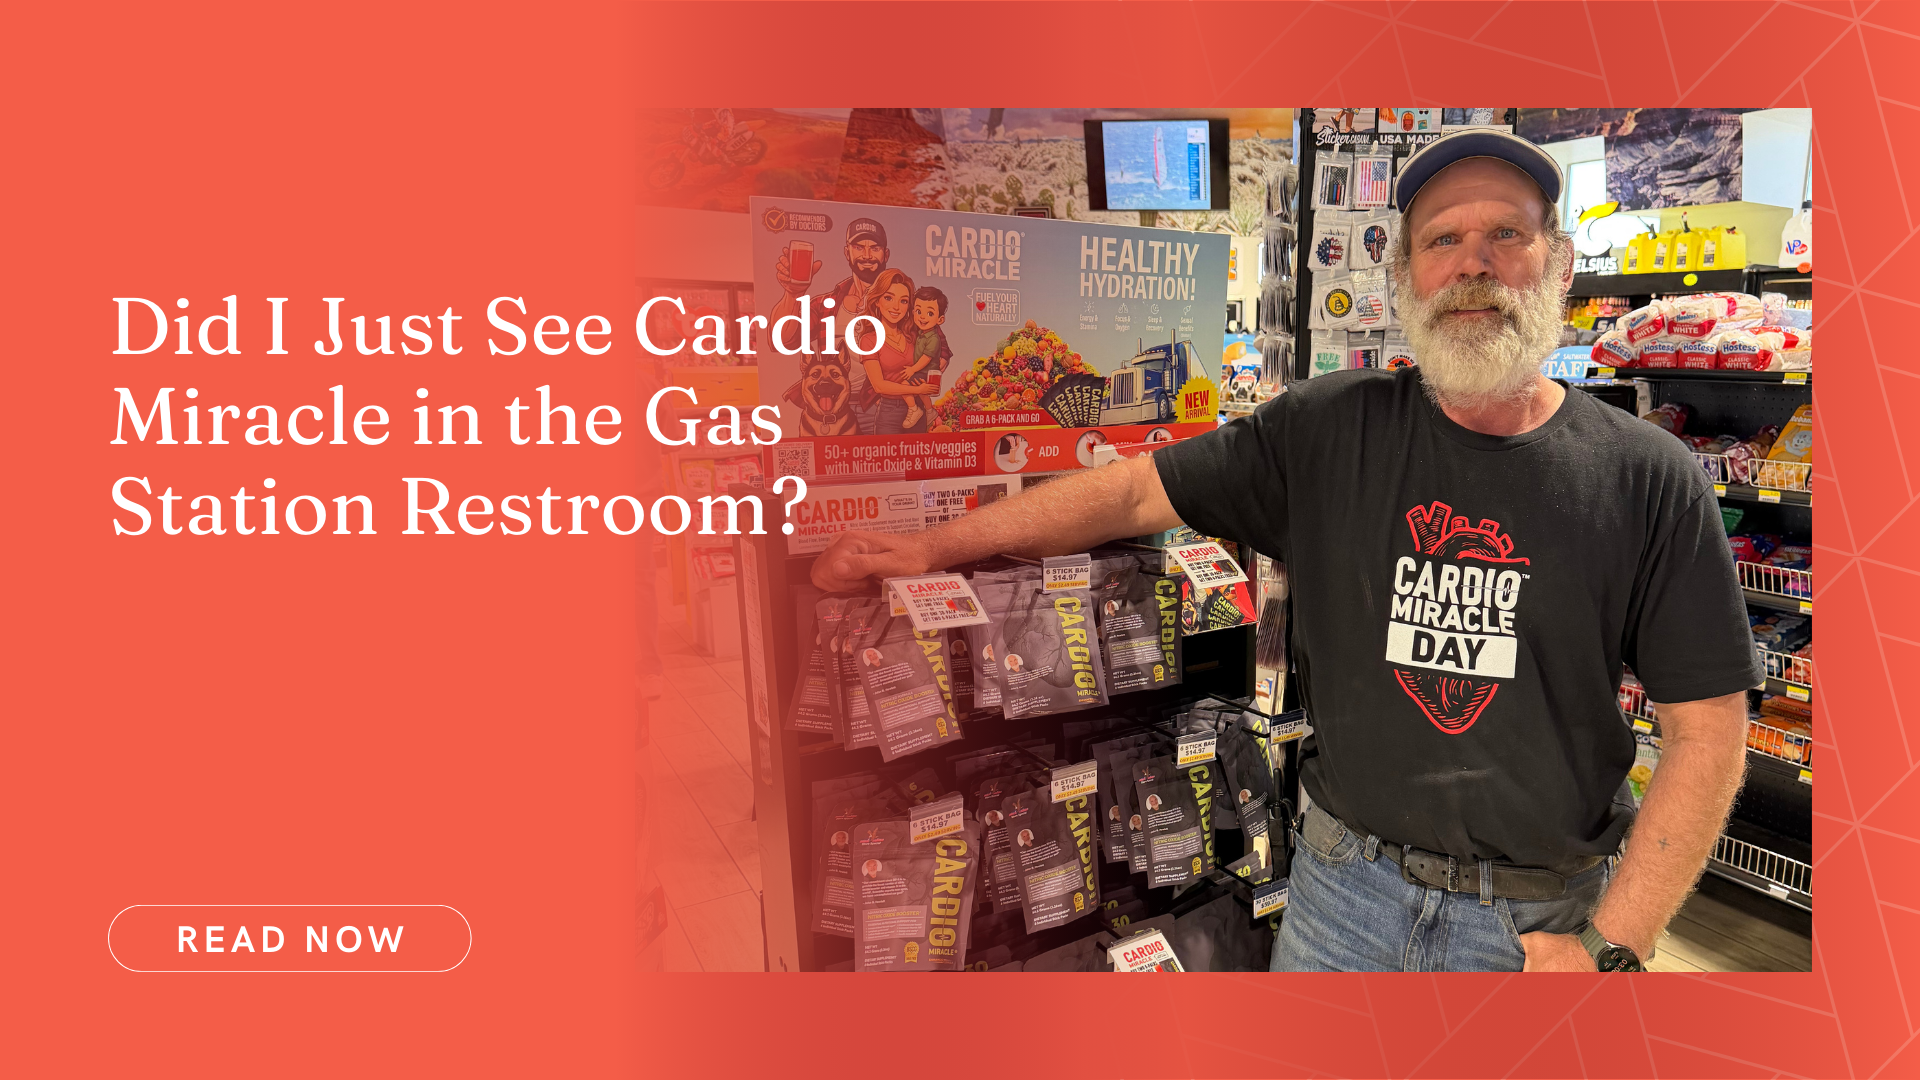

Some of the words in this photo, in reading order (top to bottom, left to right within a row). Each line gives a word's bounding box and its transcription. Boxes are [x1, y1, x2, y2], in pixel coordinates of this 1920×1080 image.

[1380, 135, 1403, 144] USA
[789, 214, 826, 223] RECOMMENDED
[798, 222, 826, 232] DOCTORS
[1080, 235, 1200, 275] HEALTHY
[925, 256, 1021, 281] MIRACLE
[1573, 256, 1618, 272] ELSIUS
[1080, 272, 1196, 301] HYDRATION!
[986, 303, 1018, 314] HEART
[975, 312, 1017, 322] NATURALLY
[1632, 325, 1656, 342] WHITE
[1673, 326, 1698, 334] WHITE
[1603, 341, 1632, 361] Hostess
[1644, 343, 1674, 352] Hostess
[1683, 343, 1714, 353] Hostess
[1722, 343, 1757, 353] Hostess
[1316, 353, 1341, 362] FREE
[1725, 361, 1754, 369] WHITE
[1185, 390, 1210, 409] NEW
[966, 413, 984, 424] GRAB
[985, 413, 991, 424] A
[991, 413, 1014, 424] 6-PACK
[1014, 413, 1030, 423] AND
[1031, 412, 1040, 423] GO
[1185, 408, 1211, 420] ARRIVAL
[825, 445, 849, 460] 50+
[852, 442, 896, 459] organic
[899, 439, 977, 458] fruits/veggies
[1039, 445, 1060, 458] ADD
[825, 461, 850, 475] with
[852, 460, 882, 474] Nitric
[883, 458, 912, 472] Oxide
[914, 458, 922, 470] &
[924, 456, 962, 469] Vitamin
[964, 455, 977, 468] D3
[923, 491, 936, 499] BUY
[937, 490, 950, 498] TWO
[951, 488, 975, 497] 6-PACKS
[936, 498, 948, 506] ONE
[949, 497, 964, 505] FREE
[796, 496, 879, 525] CARDIO
[925, 515, 937, 523] BUY
[938, 514, 950, 522] ONE
[798, 523, 847, 537] MIRACLE
[1178, 546, 1219, 559] CARDIO
[906, 580, 961, 594] CARDIO
[1390, 593, 1516, 636] MIRACLE
[1054, 597, 1096, 689] CARDIO
[1411, 630, 1487, 671] DAY
[1277, 723, 1292, 731] STICK
[1185, 742, 1203, 750] STICK
[1203, 740, 1215, 748] BAG
[1185, 748, 1206, 756] $14.97
[1060, 776, 1080, 786] STICK
[1082, 772, 1096, 780] BAG
[1061, 780, 1085, 792] $14.97
[919, 815, 944, 827] STICK
[945, 810, 961, 820] BAG
[920, 820, 949, 833] $14.97
[928, 838, 968, 947] CARDIO
[1262, 894, 1278, 902] STICK
[928, 948, 954, 956] MIRACLE
[1123, 940, 1164, 963] CARDIO
